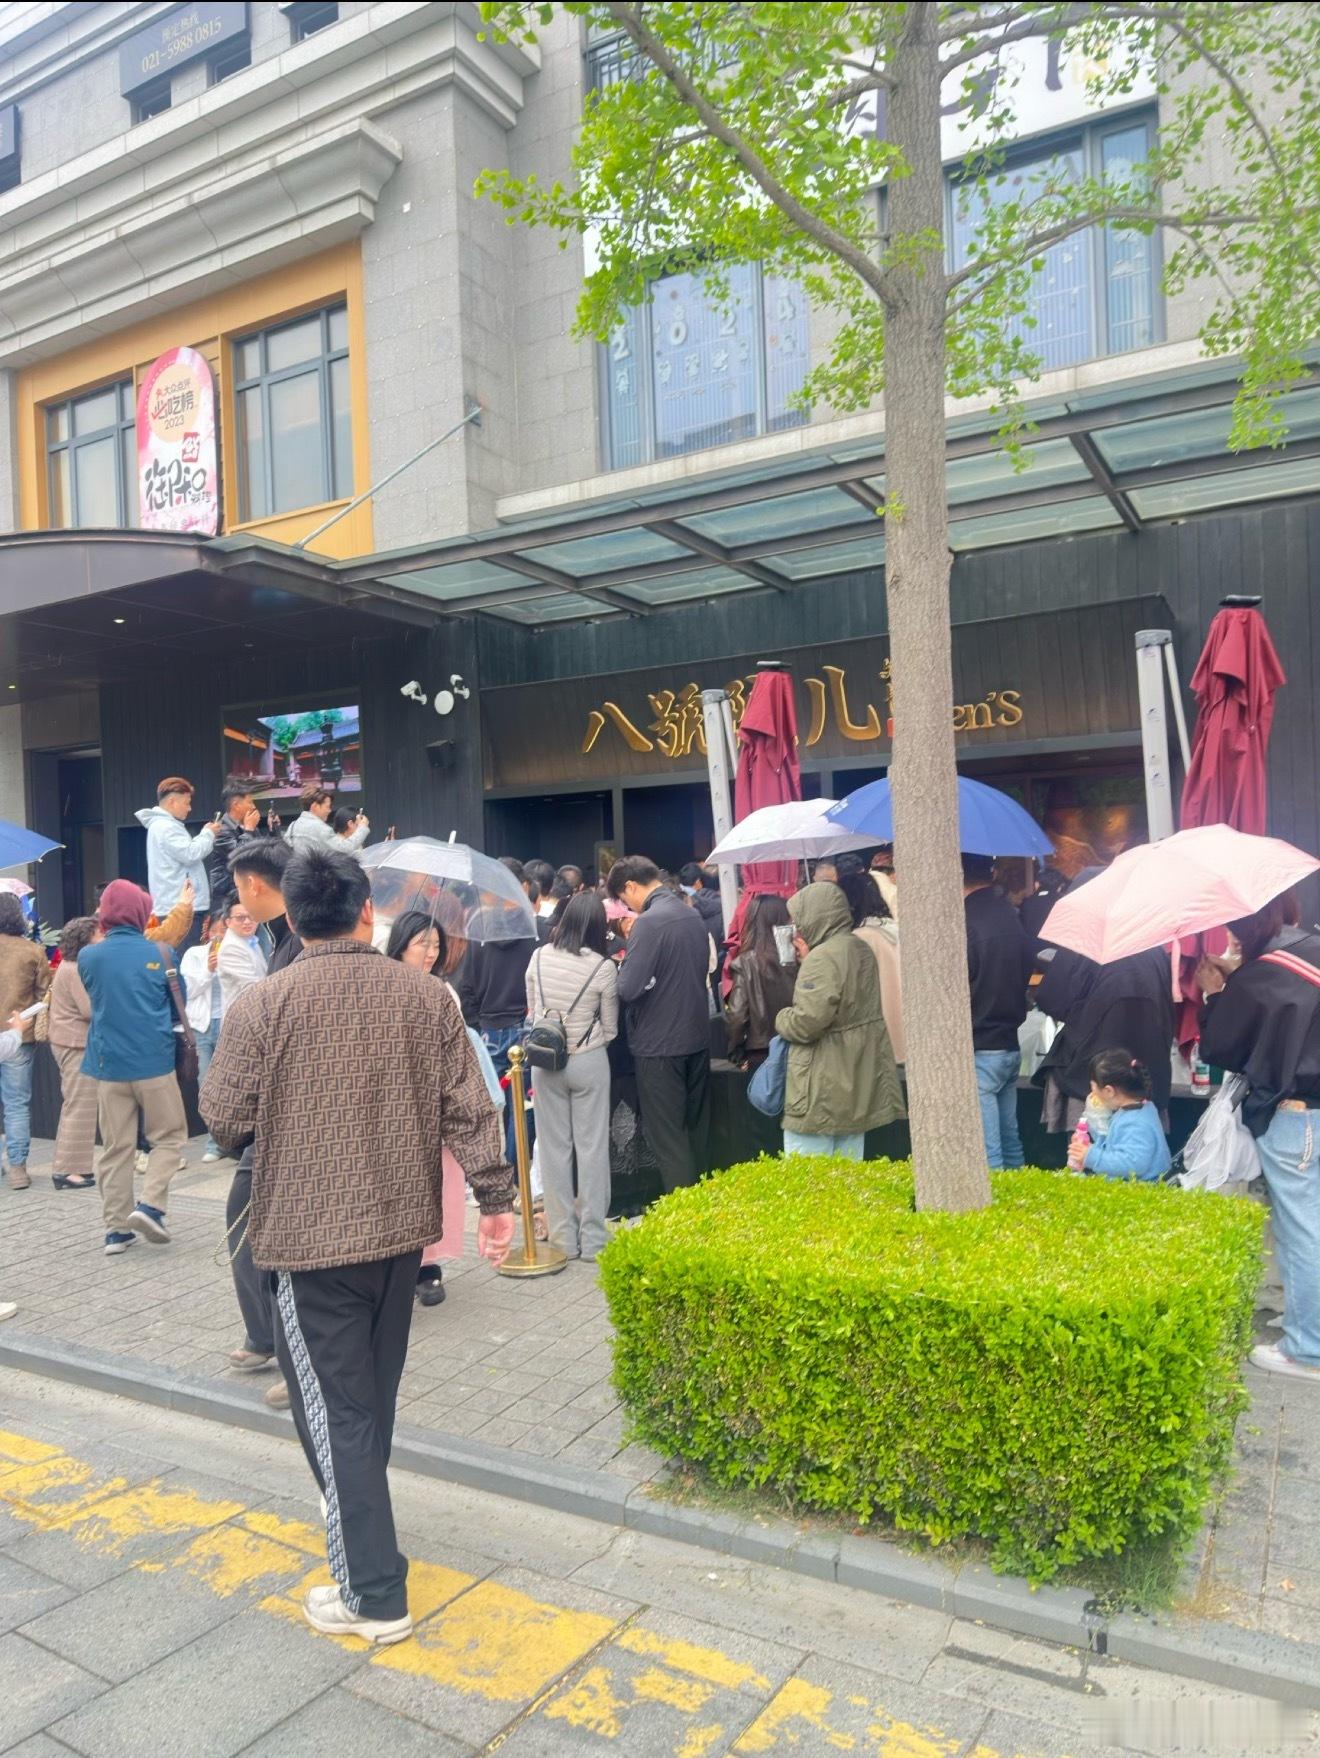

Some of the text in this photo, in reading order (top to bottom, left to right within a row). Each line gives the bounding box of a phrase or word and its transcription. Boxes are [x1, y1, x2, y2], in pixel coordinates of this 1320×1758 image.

[142, 16, 222, 72] 021-5988 0815
[164, 379, 191, 396] 大众点评
[151, 391, 194, 420] 必吃榜
[164, 415, 185, 430] 2023
[581, 665, 882, 757] 八號儿
